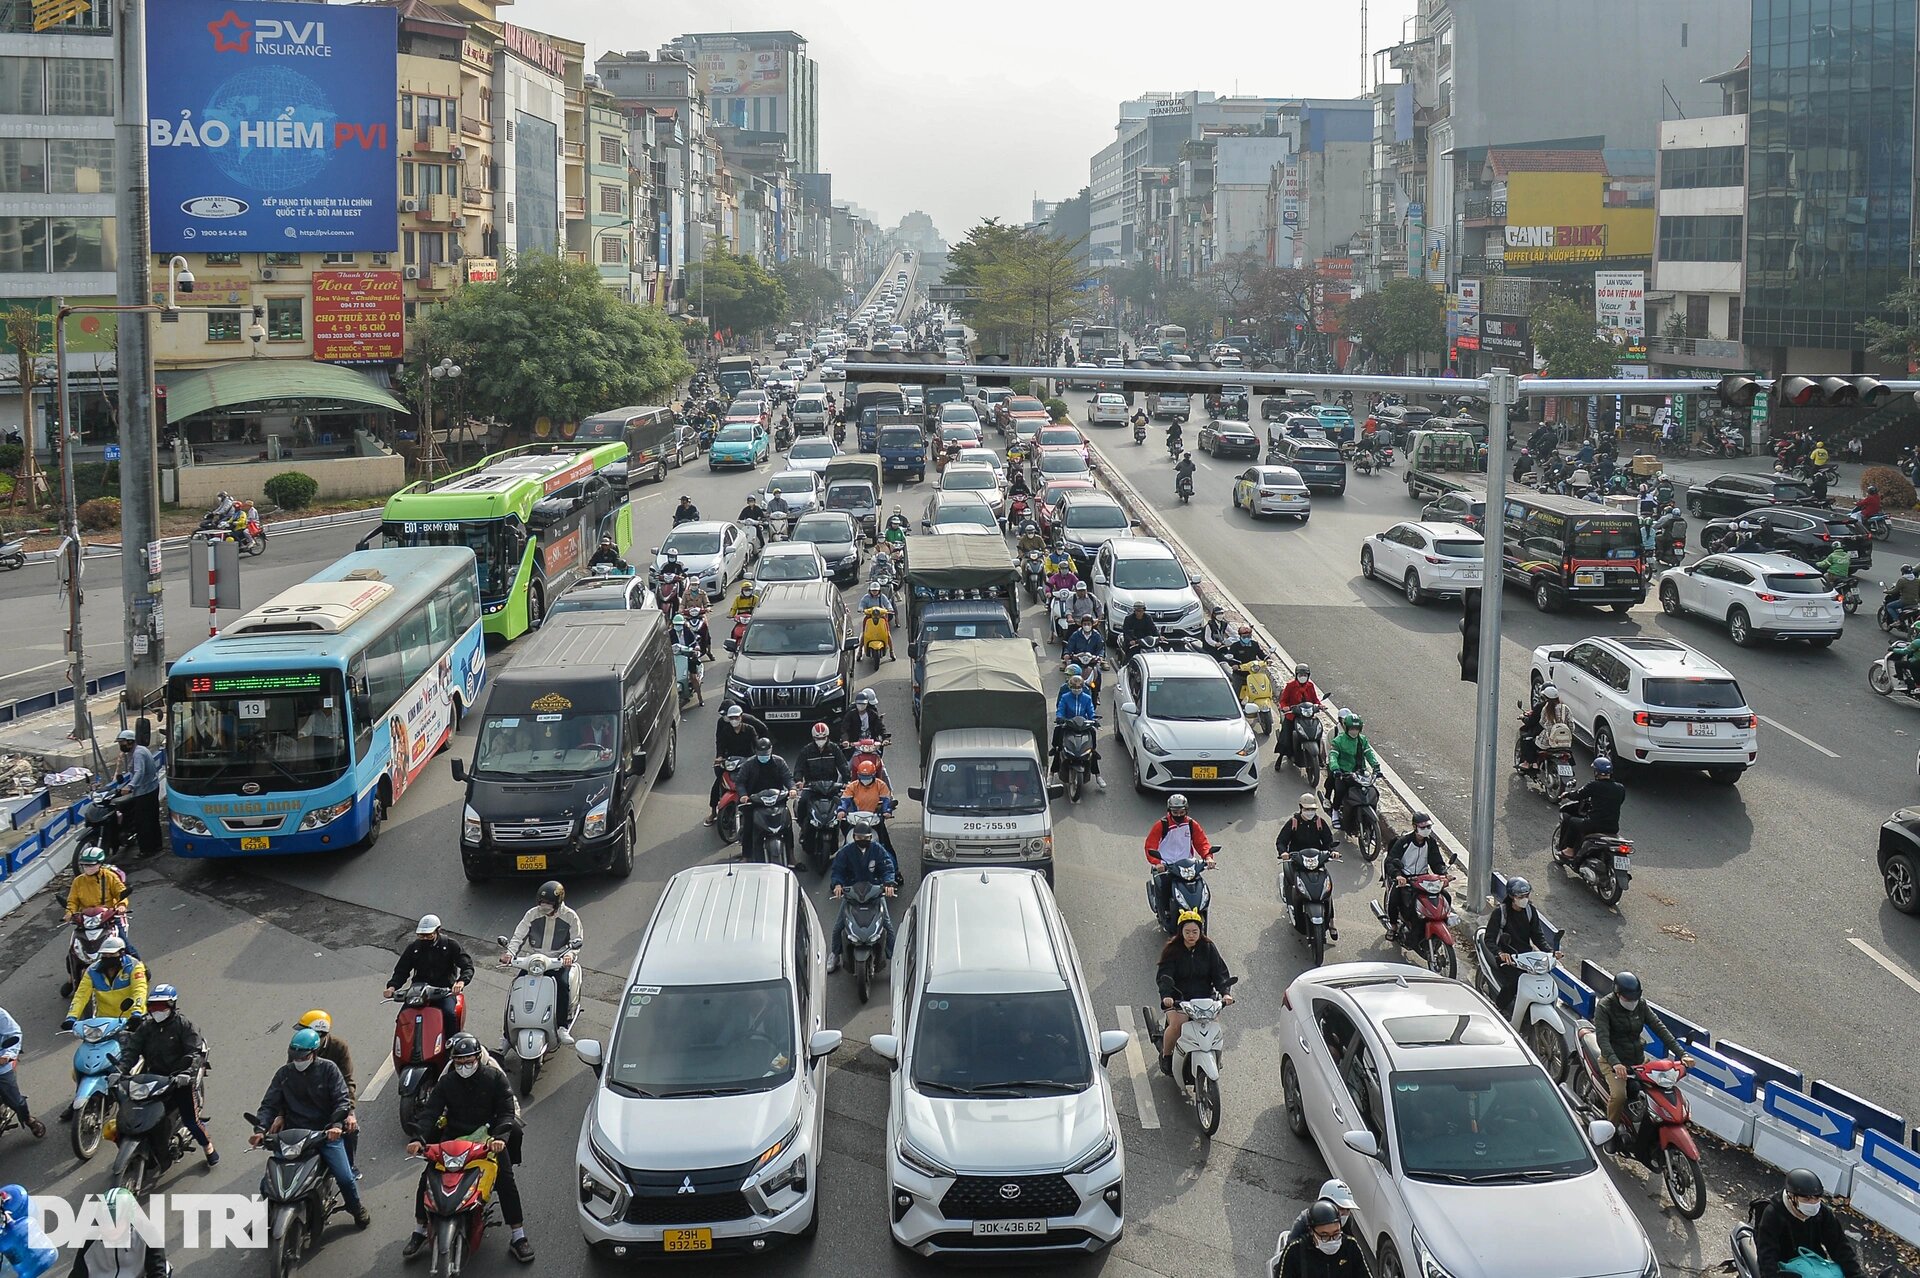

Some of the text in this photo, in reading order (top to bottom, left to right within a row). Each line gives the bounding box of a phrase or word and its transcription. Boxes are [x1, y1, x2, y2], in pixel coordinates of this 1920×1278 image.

[255, 19, 324, 45] PVI
[505, 21, 521, 54] NHA
[522, 31, 541, 66] KHOA
[255, 43, 332, 57] INSURANCE
[1156, 99, 1185, 107] TOYOTA
[150, 106, 387, 150] BẢO HIỂM PVI
[1286, 168, 1296, 176] MÁY
[262, 196, 277, 206] XẾP
[278, 198, 298, 208] HẠNG
[313, 198, 336, 208] NHIỆM
[338, 197, 350, 206] TÀI
[351, 197, 372, 206] CHÍNH
[276, 206, 296, 217] QUỐC
[297, 206, 306, 216] TẾ
[1504, 224, 1604, 247] GANG BUK
[1504, 251, 1529, 261] BUFFET
[1576, 248, 1604, 260] 179K
[317, 279, 398, 290] Hoa Tươi
[1628, 290, 1642, 298] NAM
[337, 312, 362, 322] THUÊ
[364, 314, 378, 322] XE
[380, 312, 386, 321] Ô
[388, 312, 401, 321] TÔ
[370, 322, 386, 331] CHỖ
[404, 522, 417, 534] E01
[424, 524, 432, 532] BX
[244, 704, 260, 714] 19
[963, 822, 1017, 830] 29C-755.99
[979, 1222, 1041, 1234] 30K-436.62
[676, 1230, 698, 1240] 29H
[669, 1240, 707, 1250] 932.56
